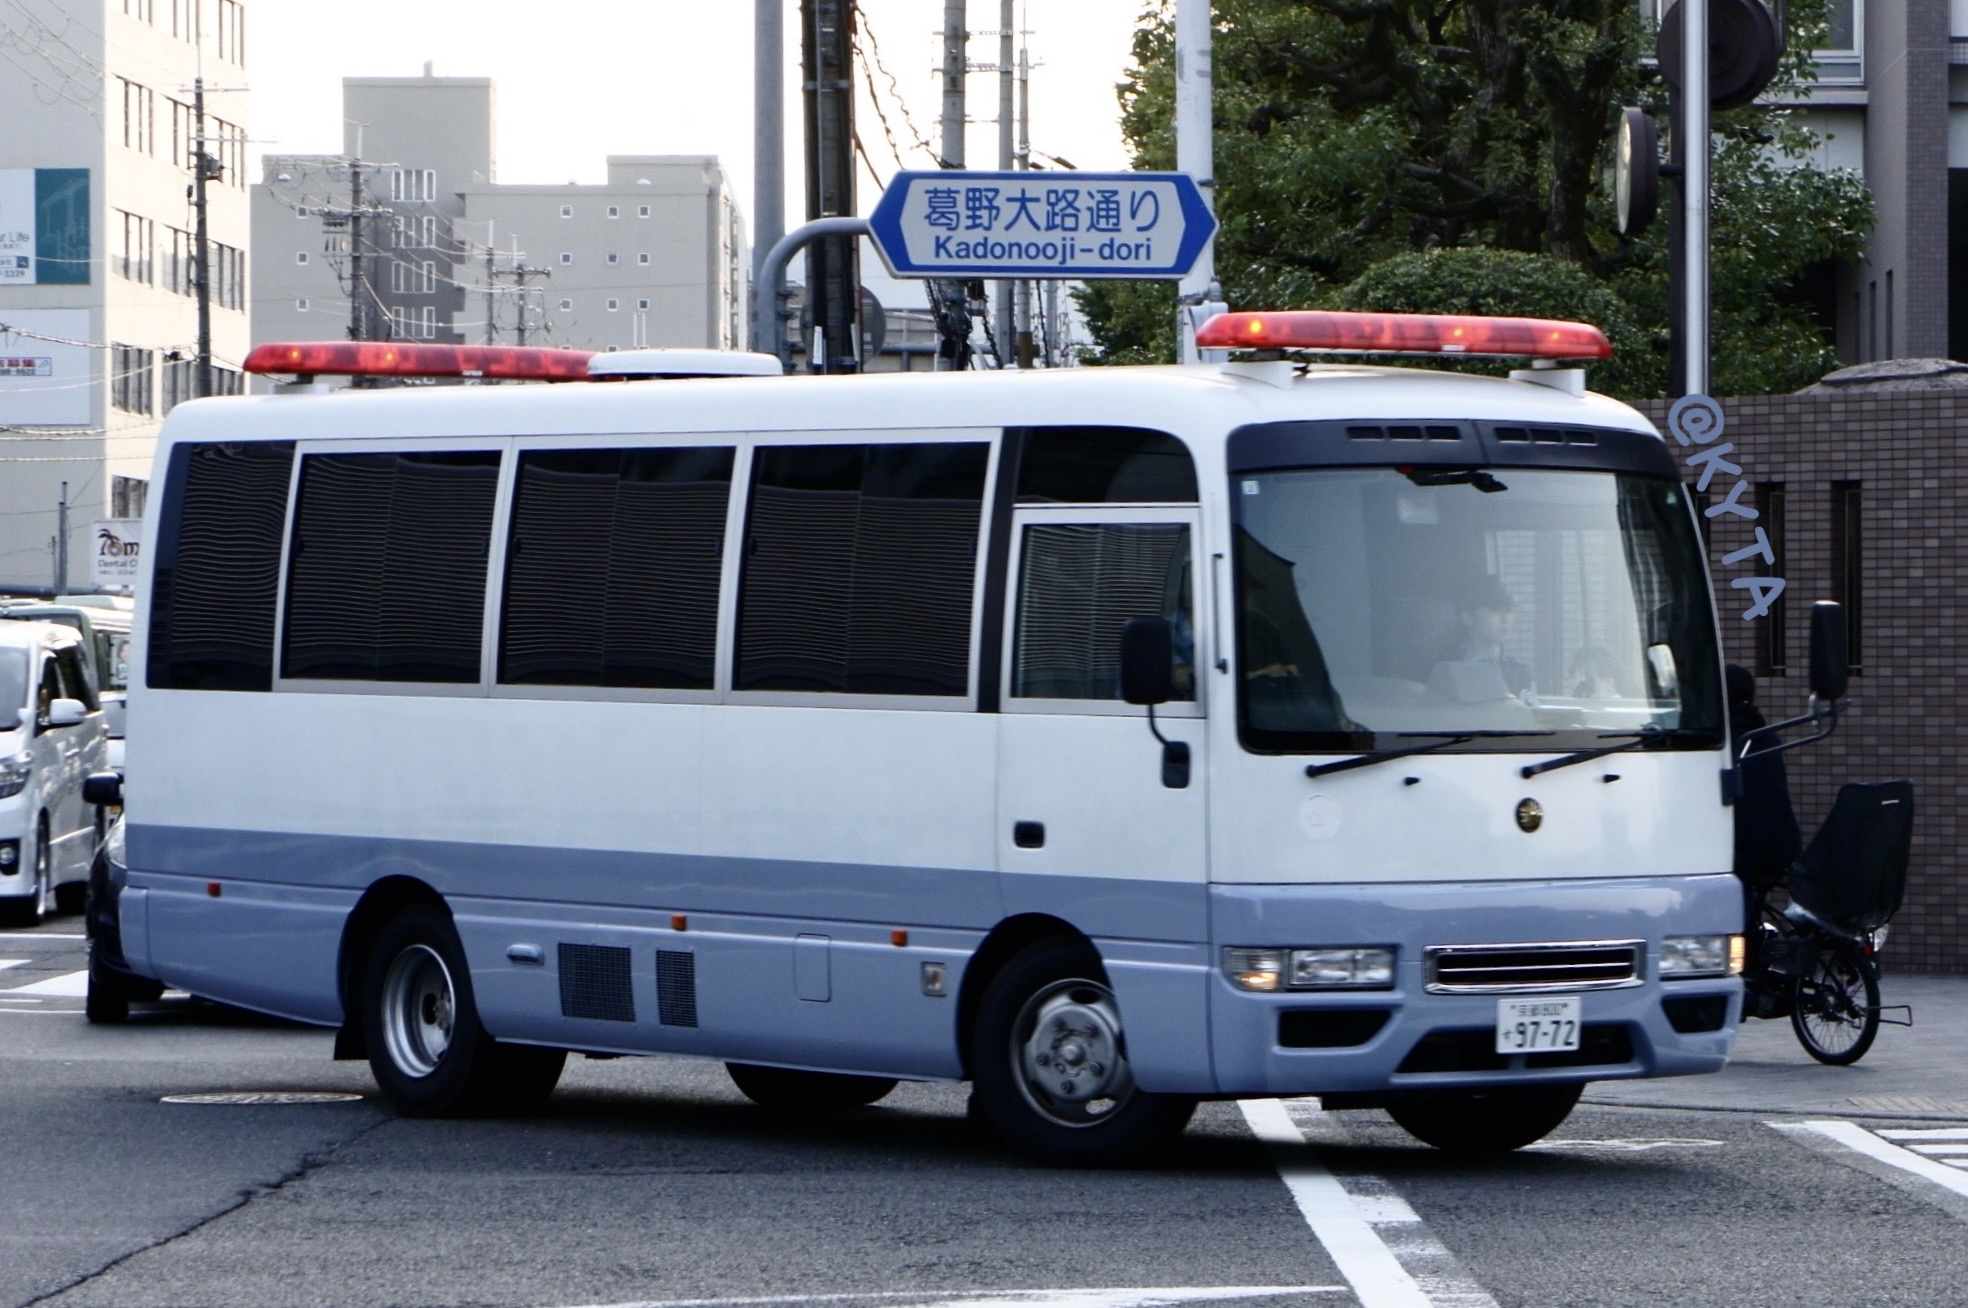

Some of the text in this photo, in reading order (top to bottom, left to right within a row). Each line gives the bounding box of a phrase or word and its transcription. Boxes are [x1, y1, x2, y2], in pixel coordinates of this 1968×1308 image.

[924, 187, 1160, 233] 葛野大路通り
[934, 236, 1152, 265] Kadonooji-dori
[97, 559, 128, 568] Dental
[1514, 1020, 1576, 1048] 97-72
